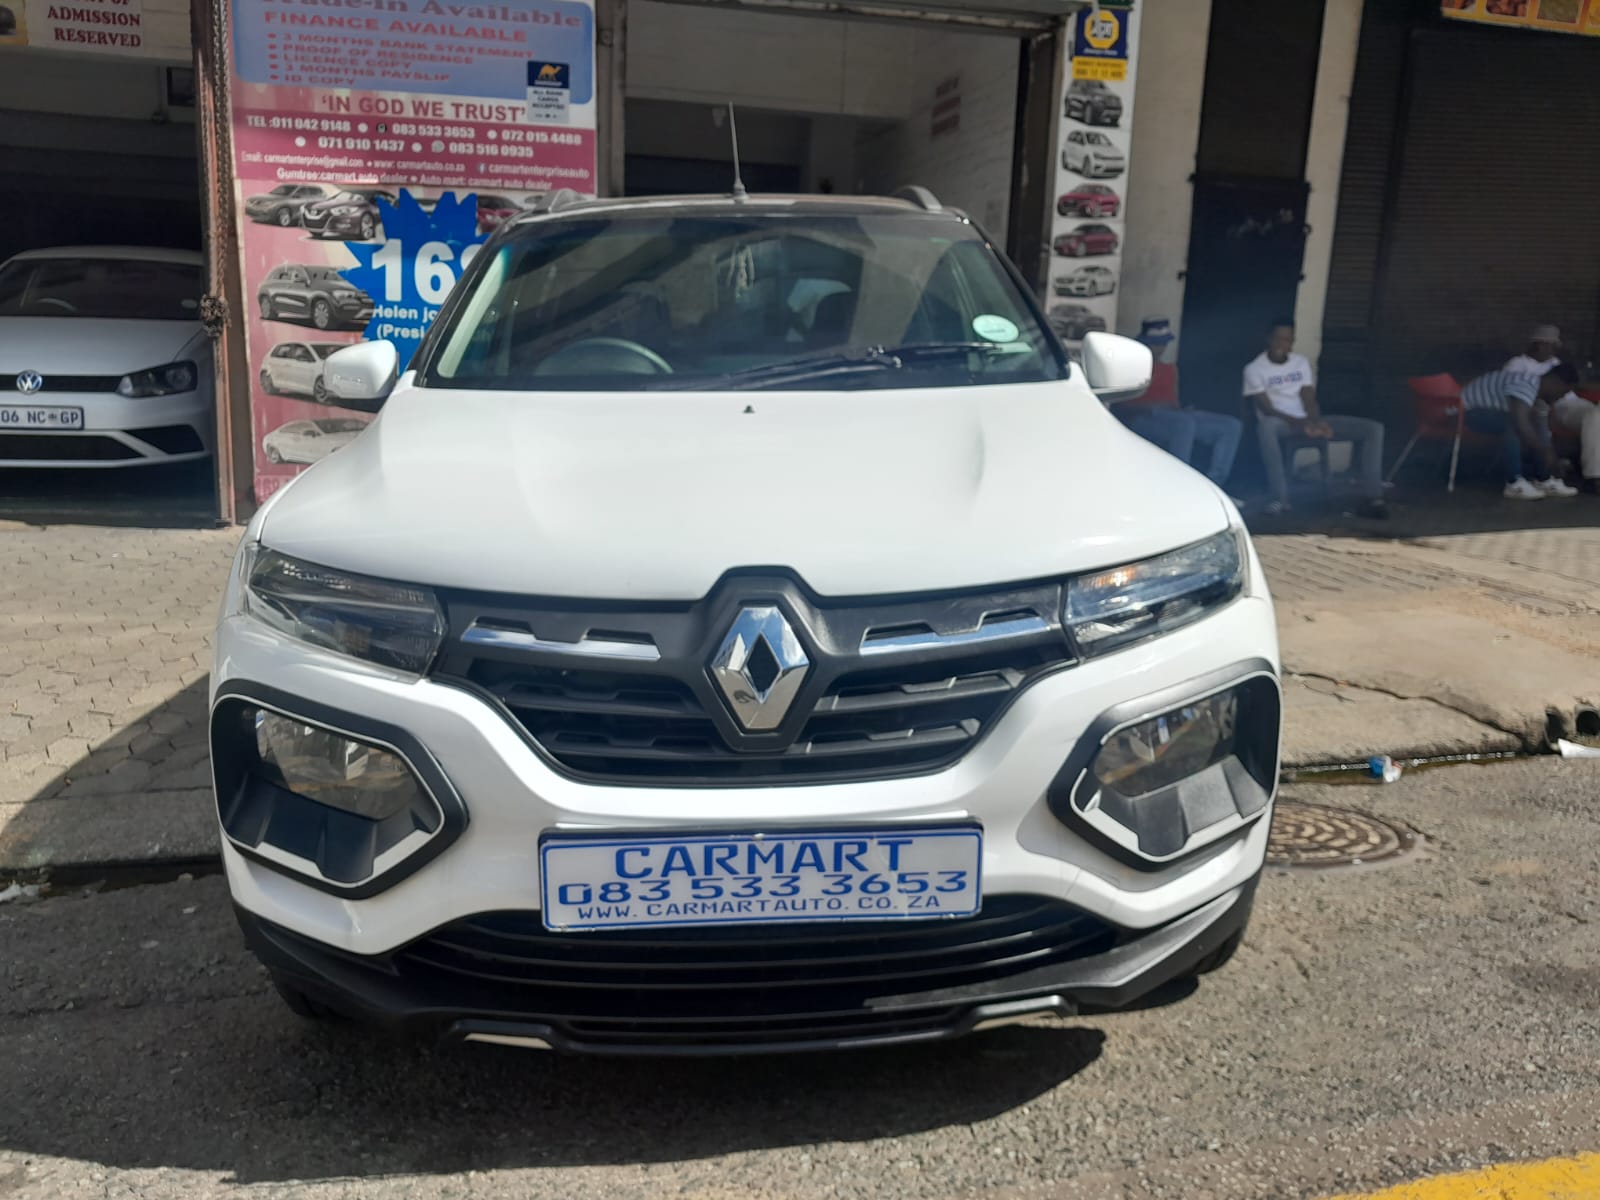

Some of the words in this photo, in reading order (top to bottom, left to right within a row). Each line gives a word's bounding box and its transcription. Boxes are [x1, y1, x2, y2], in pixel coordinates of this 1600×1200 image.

[47, 5, 140, 26] ADMISSION
[420, 0, 581, 27] Available
[54, 27, 141, 47] RESERVED
[264, 11, 380, 30] FINANCE
[389, 19, 526, 42] AVAILABLE
[283, 44, 341, 54] PROOF
[348, 49, 370, 57] OF
[376, 51, 474, 65] RESIDENCE
[298, 34, 375, 47] MONTHS
[379, 39, 430, 50] BANK
[434, 43, 535, 59] STATEMENT
[283, 54, 359, 66] LICENCE
[365, 60, 413, 70] COPY
[299, 66, 376, 78] MONTHS
[380, 71, 451, 82] PAYSLIP
[308, 77, 356, 86] COPY
[358, 97, 405, 116] GOD
[411, 100, 443, 118] WE
[247, 115, 268, 129] TEL
[372, 304, 419, 320] Helen
[27, 410, 46, 424] NC
[60, 411, 79, 425] GP
[615, 839, 913, 879] CARMART
[558, 880, 671, 905] 083
[691, 874, 801, 900] 533
[821, 870, 968, 896] 3653
